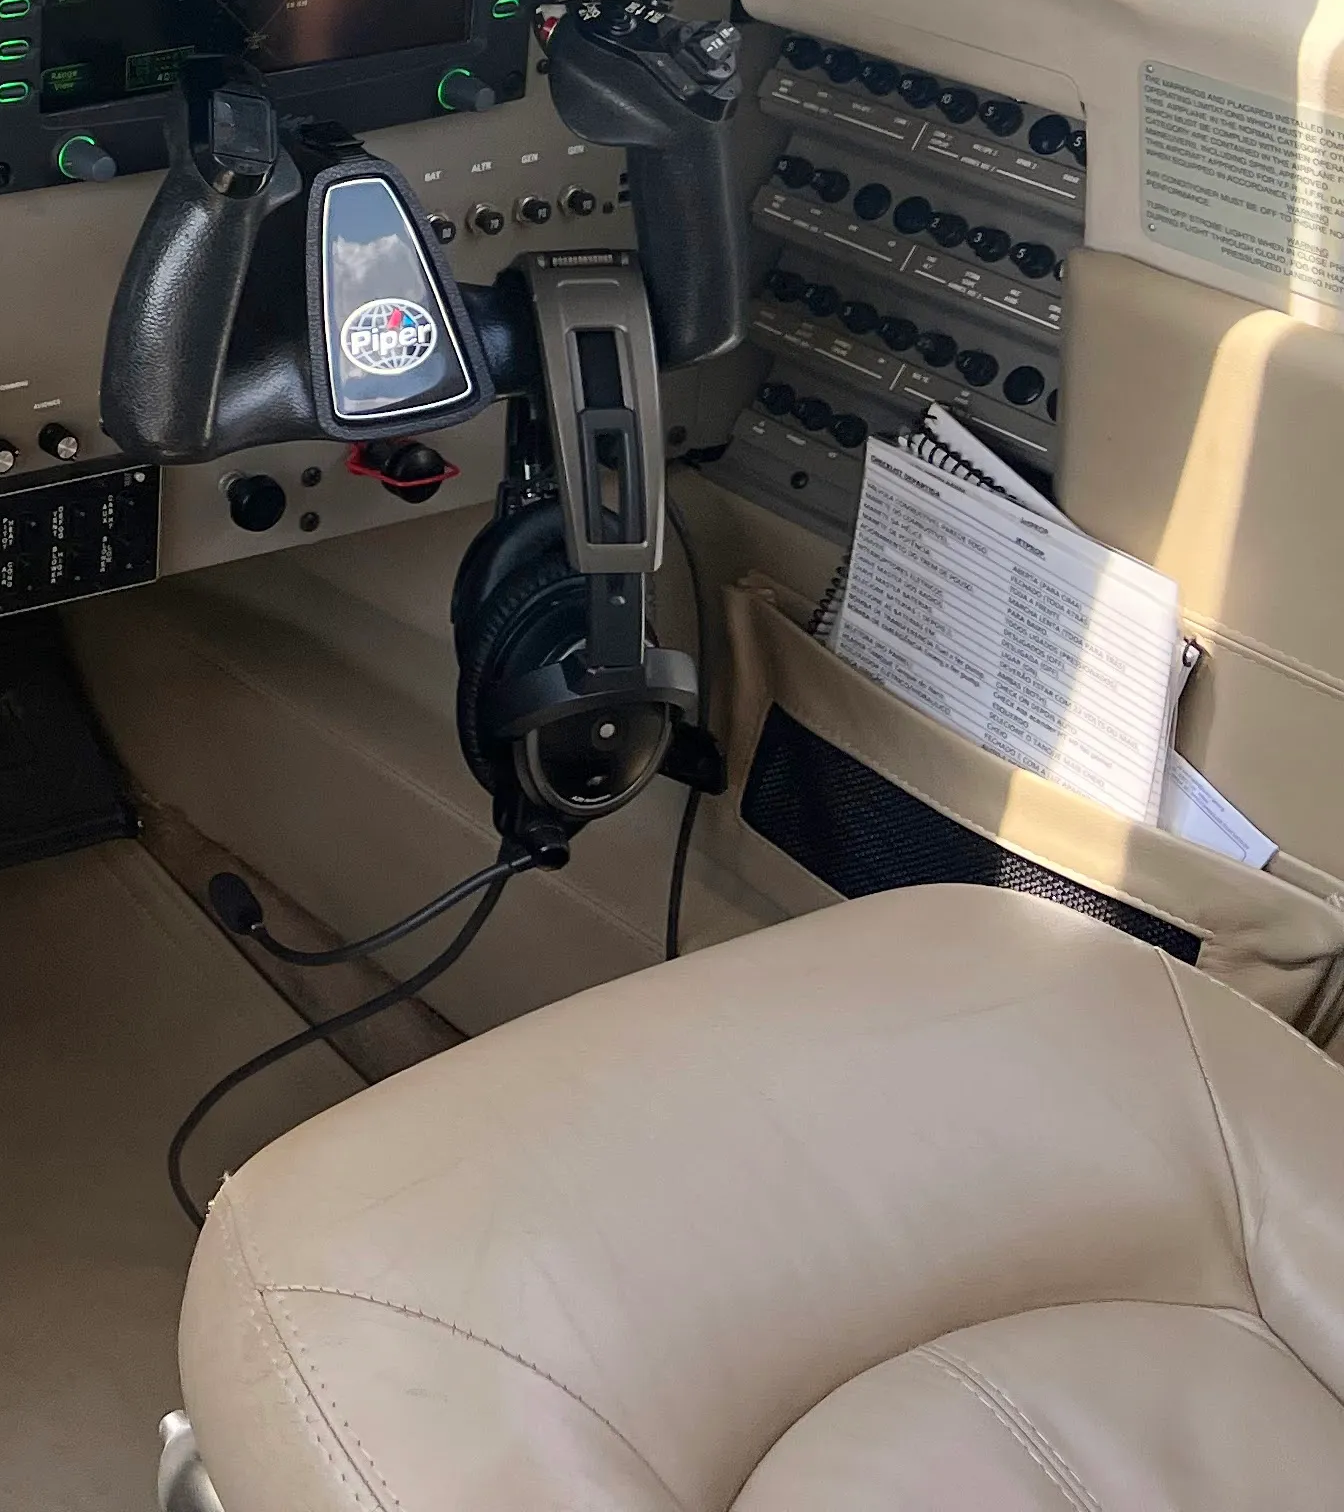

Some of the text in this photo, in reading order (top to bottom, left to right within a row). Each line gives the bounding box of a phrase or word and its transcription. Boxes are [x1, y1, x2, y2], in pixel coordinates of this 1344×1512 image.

[1227, 97, 1323, 135] PLACARDS INSTALLED
[471, 161, 493, 173] ALTR
[521, 153, 539, 164] GEN
[424, 170, 442, 182] BAT
[1221, 246, 1281, 274] PRESSURIZED
[350, 322, 432, 356] Piper
